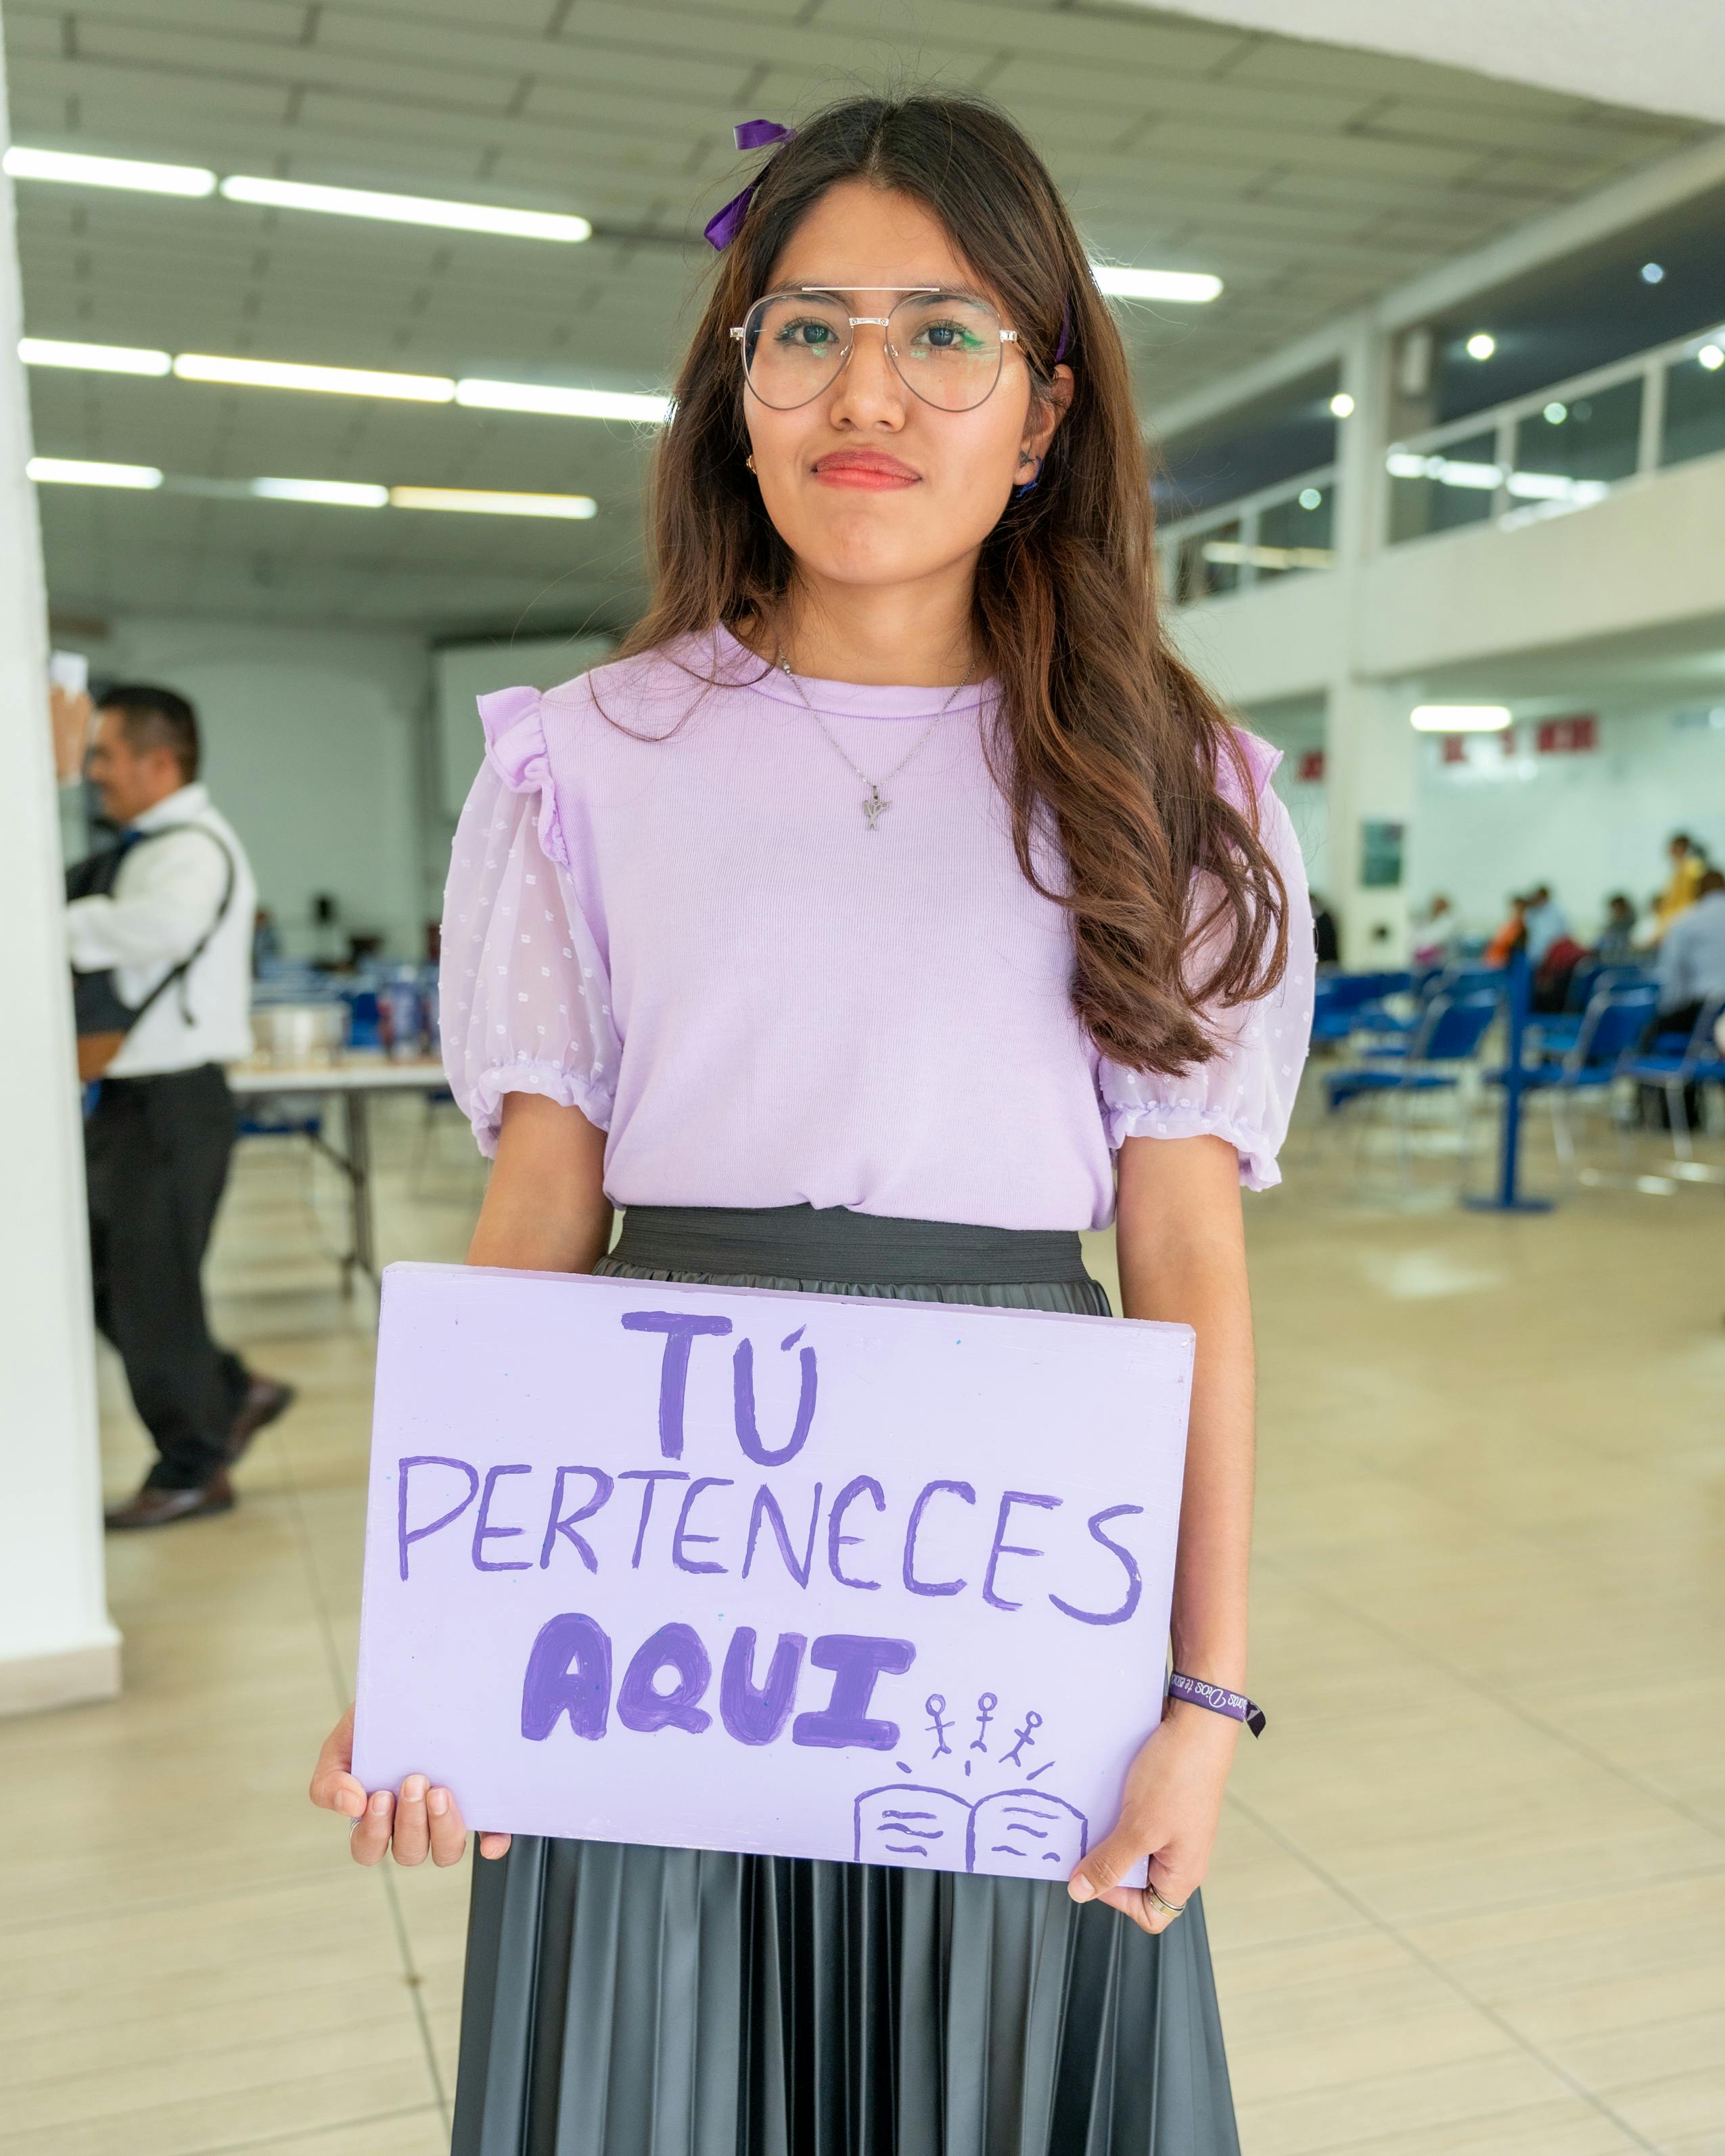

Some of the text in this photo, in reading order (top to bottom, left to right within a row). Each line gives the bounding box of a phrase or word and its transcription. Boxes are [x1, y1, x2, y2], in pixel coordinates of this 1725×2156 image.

[620, 1310, 818, 1467] TÚ
[398, 1455, 1144, 1626] PERTENECES
[521, 1612, 917, 1751] AQUI
[1184, 1679, 1194, 1693] te
[1195, 1682, 1226, 1707] Dios
